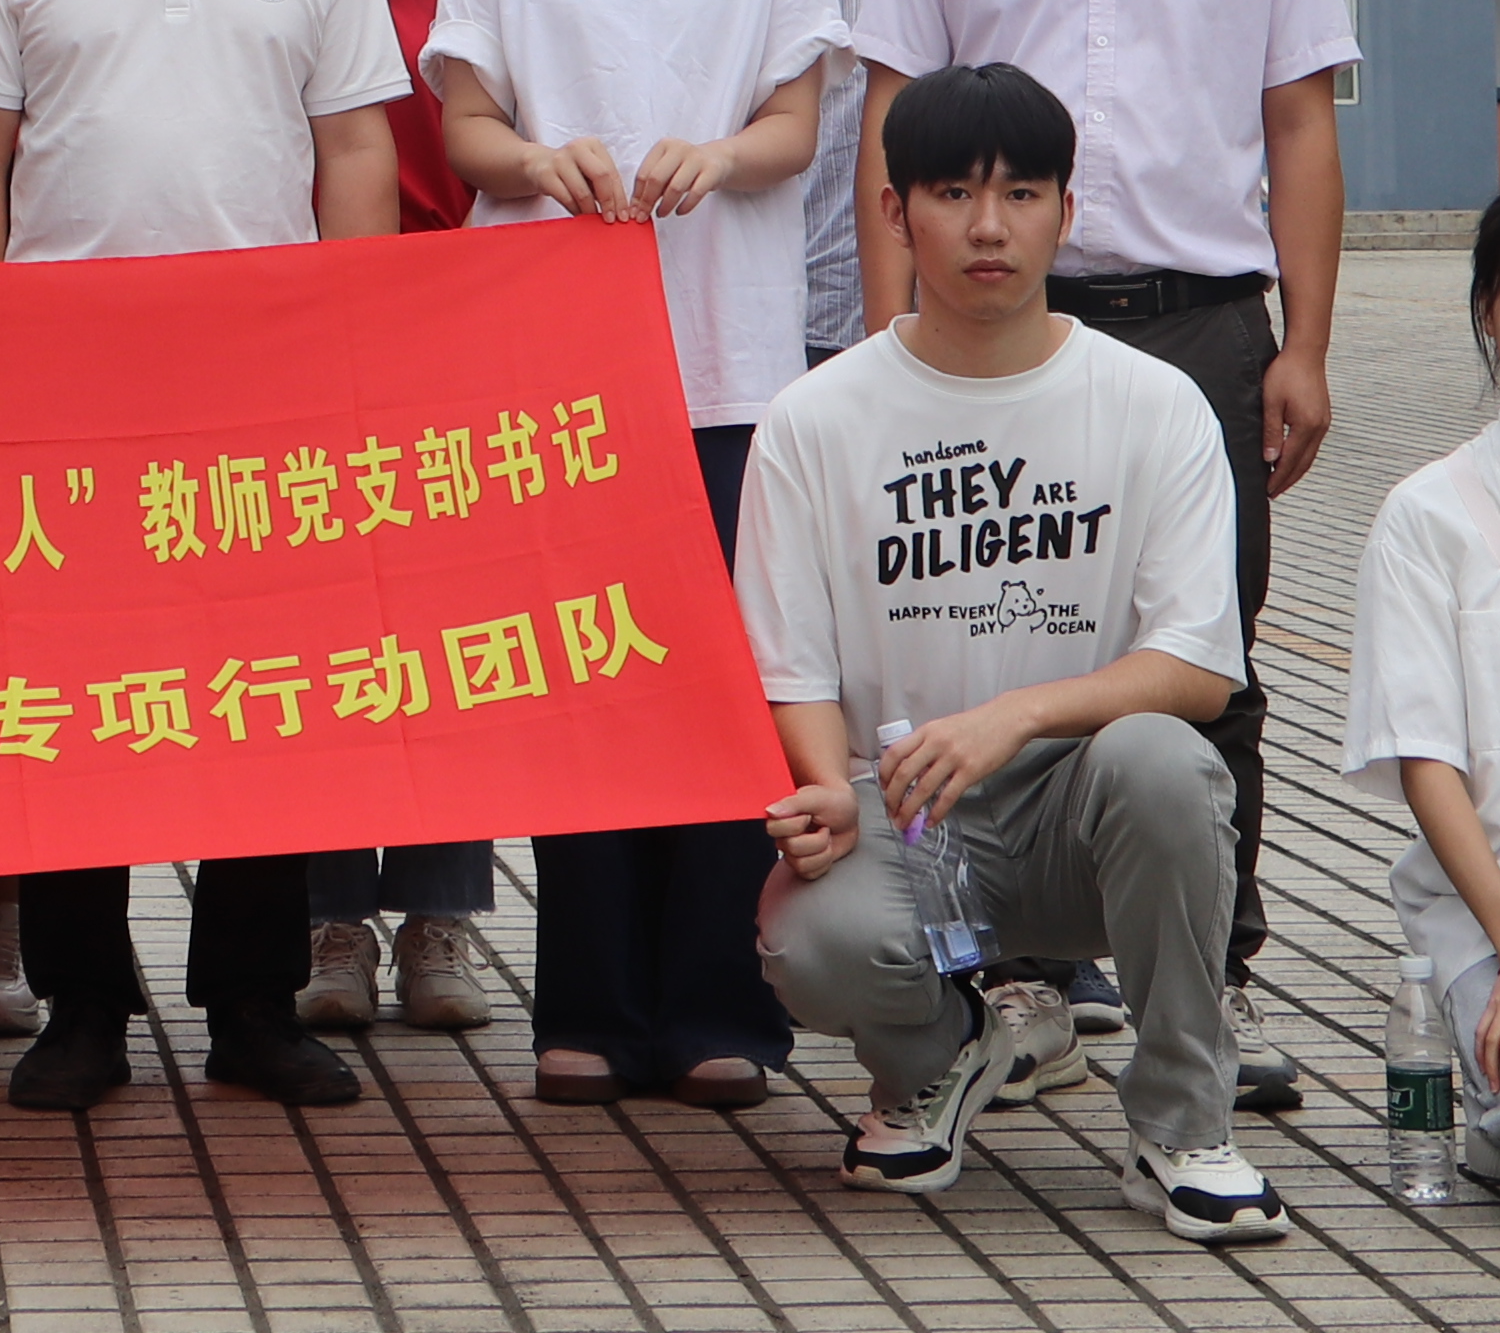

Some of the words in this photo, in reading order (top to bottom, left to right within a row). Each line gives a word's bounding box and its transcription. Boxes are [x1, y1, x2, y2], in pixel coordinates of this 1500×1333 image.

[903, 440, 988, 468] handsome
[884, 457, 1027, 524] THEY
[1032, 481, 1077, 506] ARE
[878, 504, 1111, 585] DILIGENT
[888, 605, 942, 622] HAPPY
[948, 603, 996, 620] EVERY
[1048, 604, 1080, 618] THE
[970, 621, 997, 637] DAY
[1047, 620, 1096, 635] OCEAN
